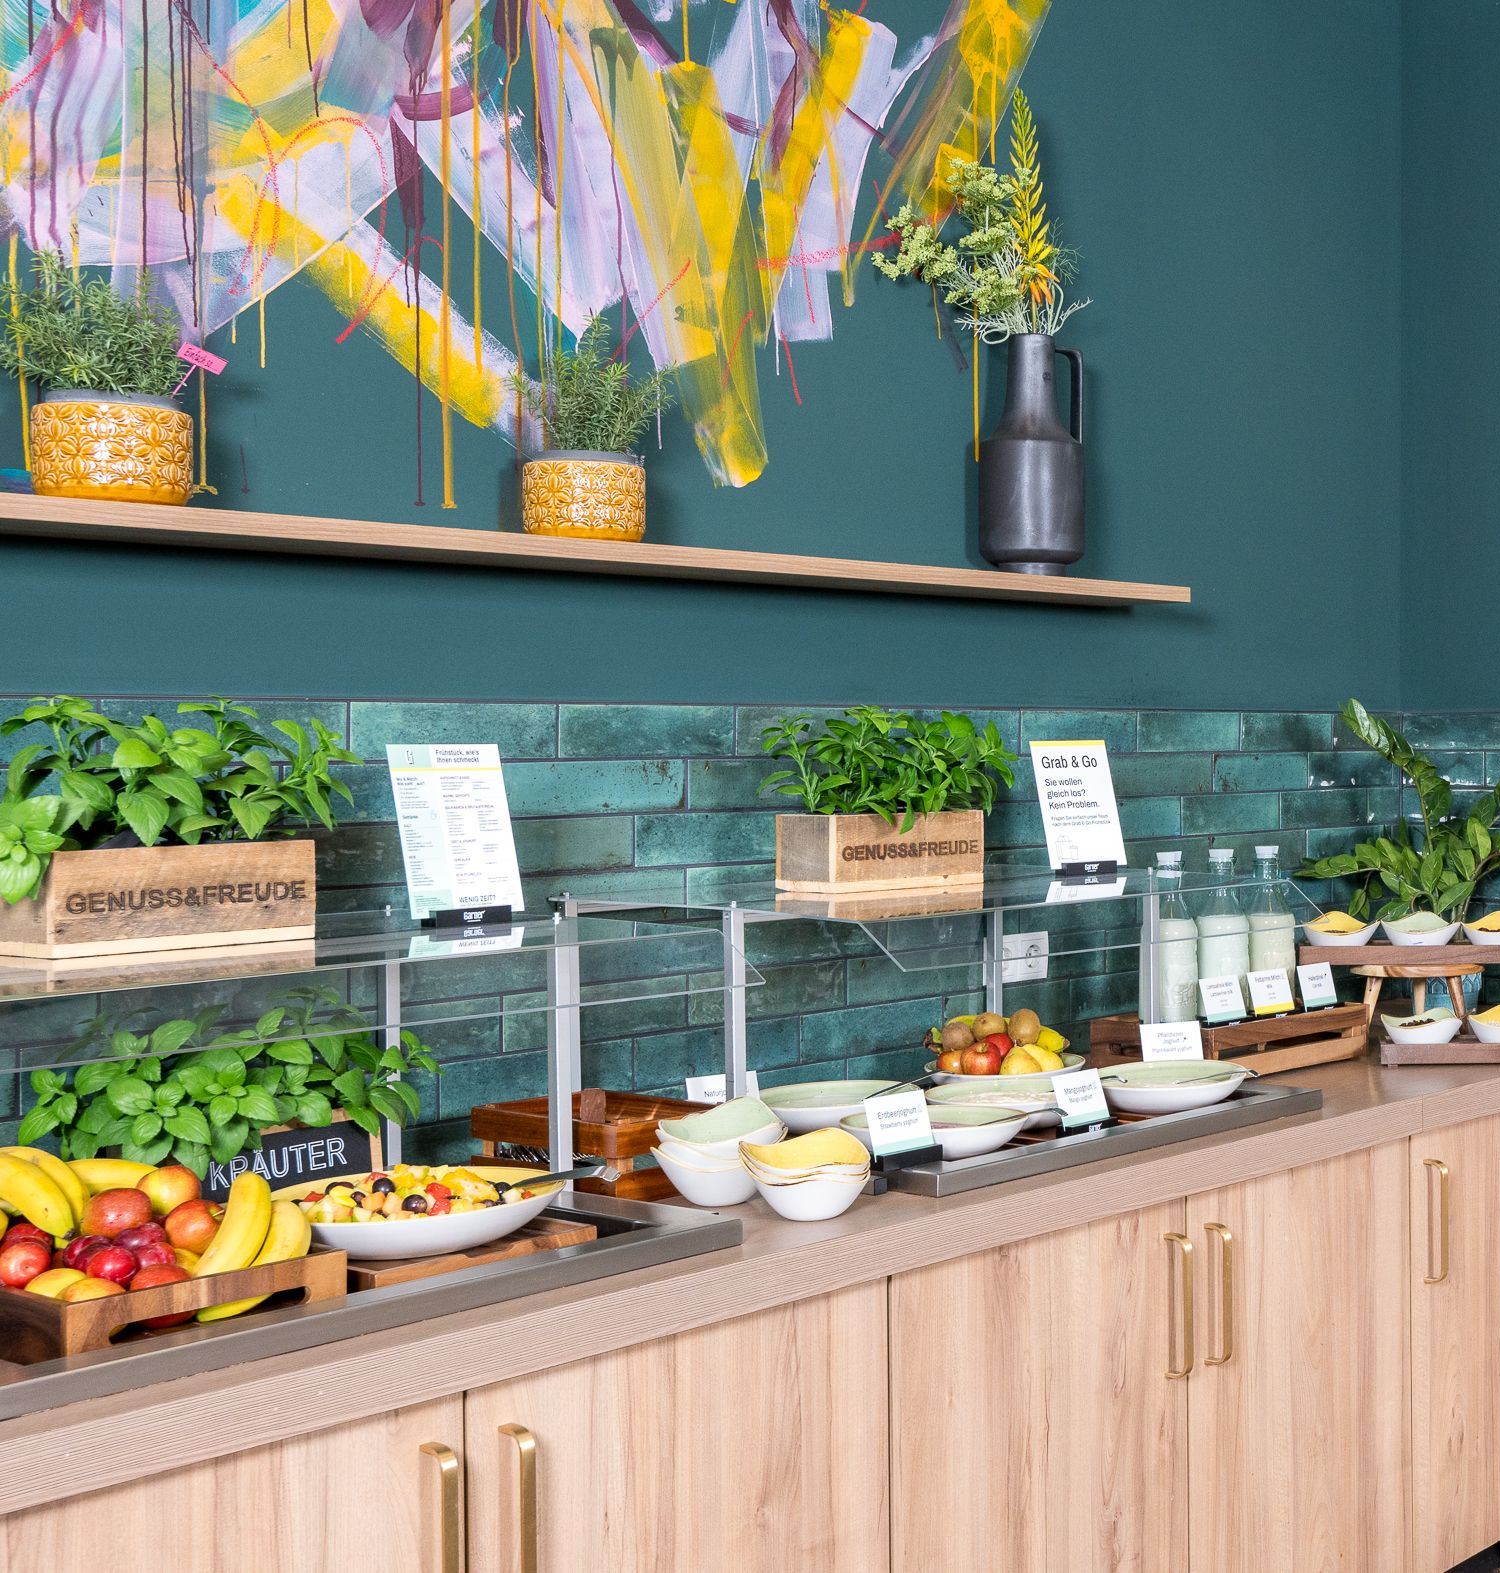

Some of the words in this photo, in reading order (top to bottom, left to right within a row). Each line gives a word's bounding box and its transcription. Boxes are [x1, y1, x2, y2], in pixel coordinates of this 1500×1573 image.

[1041, 755, 1068, 769] Grab
[1071, 755, 1080, 769] &
[1081, 755, 1097, 768] Go
[1044, 778, 1057, 786] Sie
[1058, 777, 1082, 786] wollen
[1047, 789, 1070, 799] gleich
[1070, 788, 1086, 797] los?
[1048, 801, 1066, 809] Kein
[1067, 800, 1101, 809] Problem.
[842, 840, 979, 862] GENUSS&FREUDE
[65, 880, 307, 914] GENUSS&FREUDE
[480, 894, 496, 902] ZEIT?
[877, 1107, 917, 1120] Erdbeerjoghurt
[209, 1136, 347, 1191] KRÄUTER
